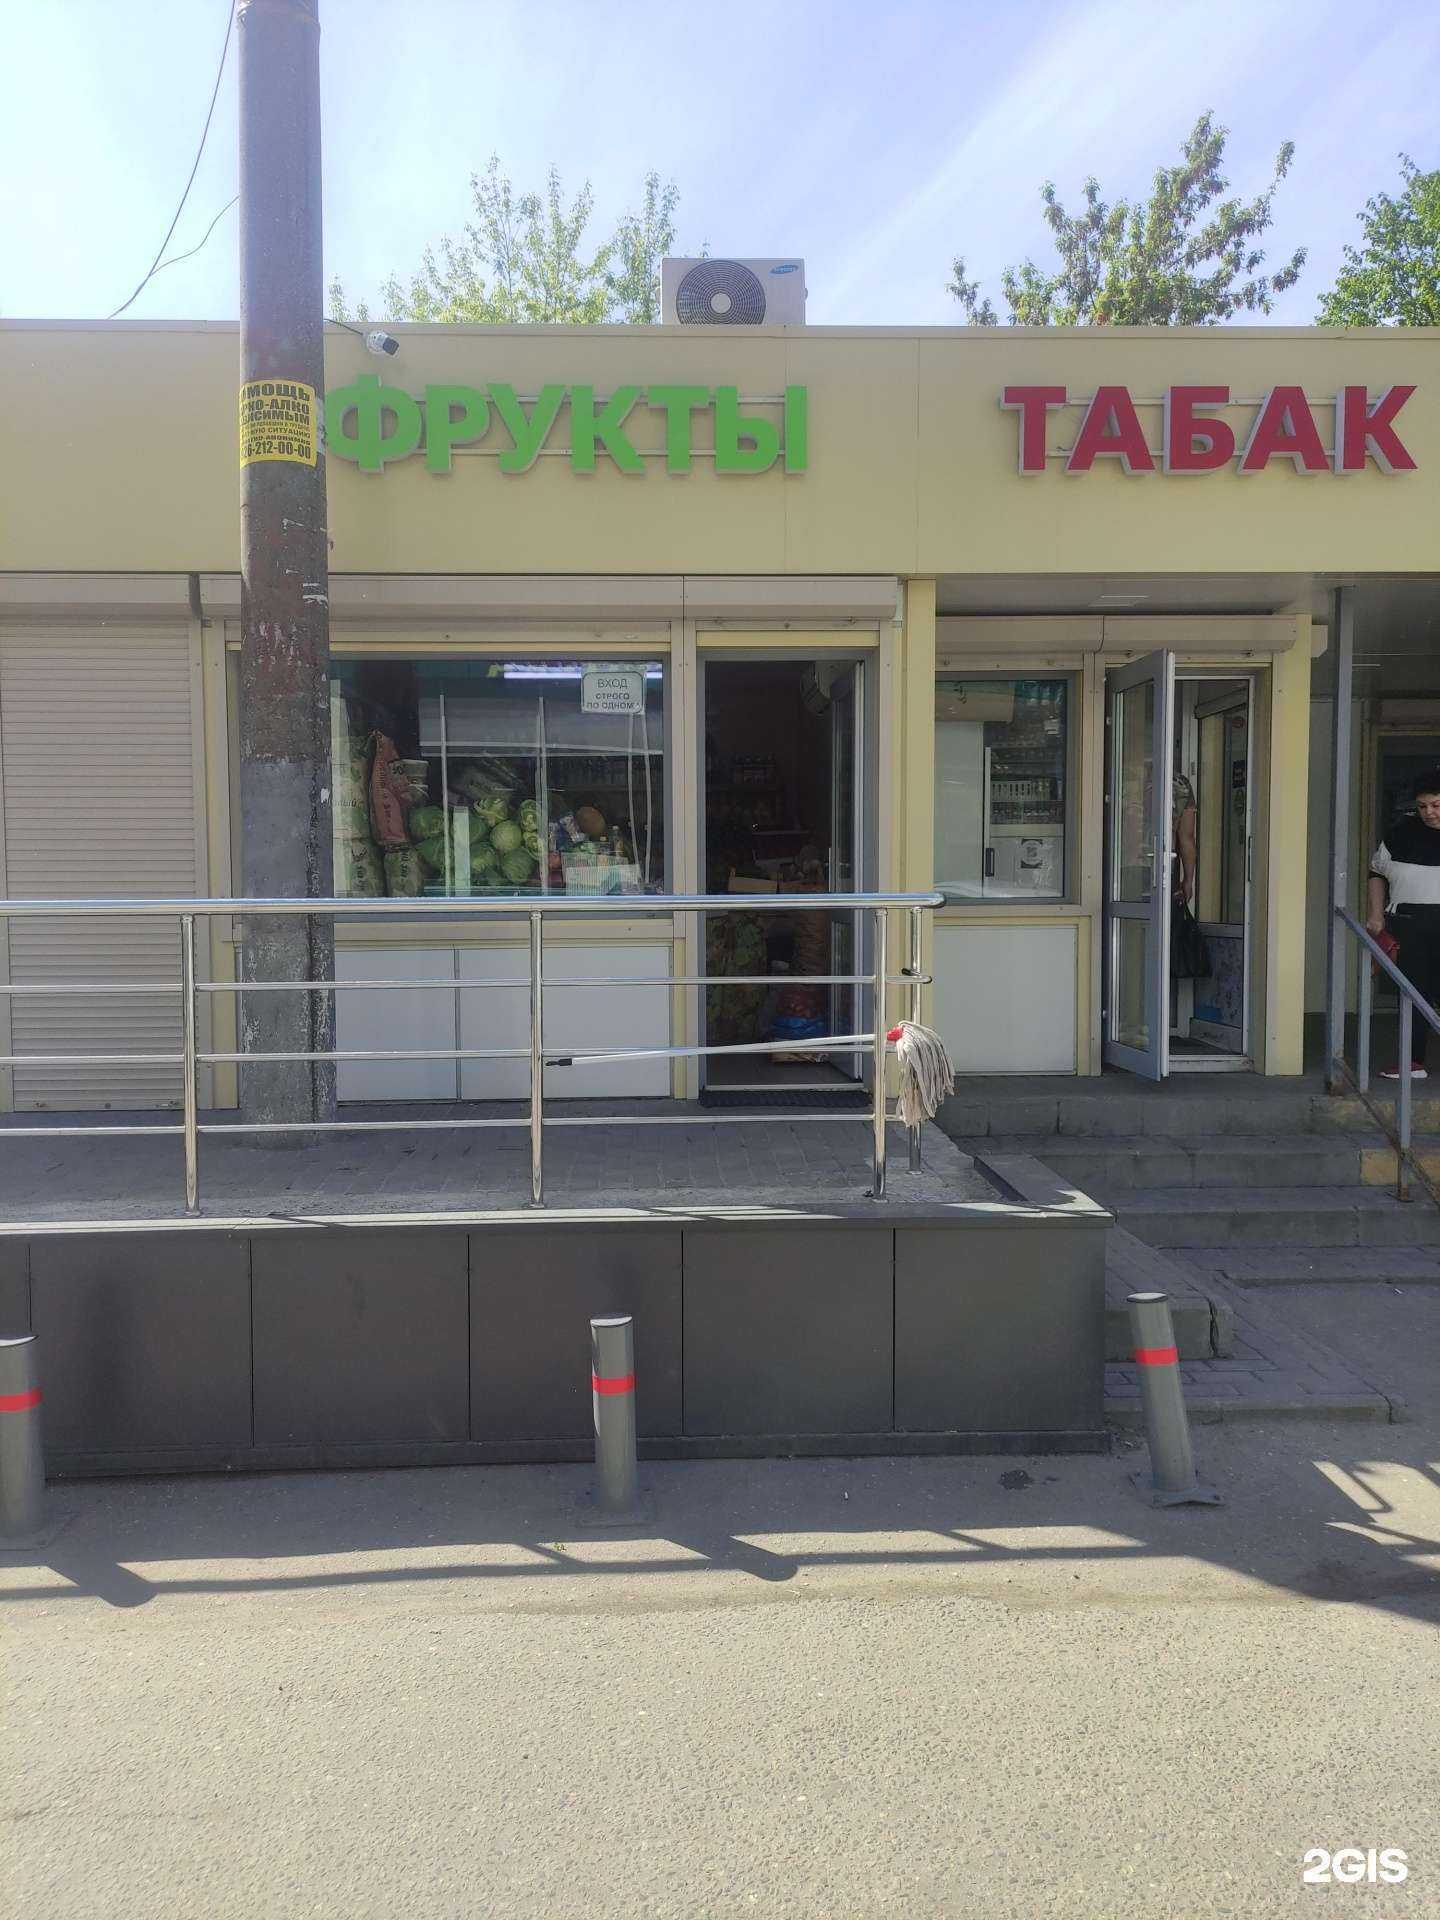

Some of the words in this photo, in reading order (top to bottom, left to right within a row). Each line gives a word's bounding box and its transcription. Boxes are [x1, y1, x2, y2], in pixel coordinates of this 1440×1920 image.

[325, 374, 808, 475] ФРУКТЫ
[1002, 385, 1418, 475] ТАБАК
[595, 692, 630, 700] СТРОГО
[597, 679, 628, 689] ВХОД
